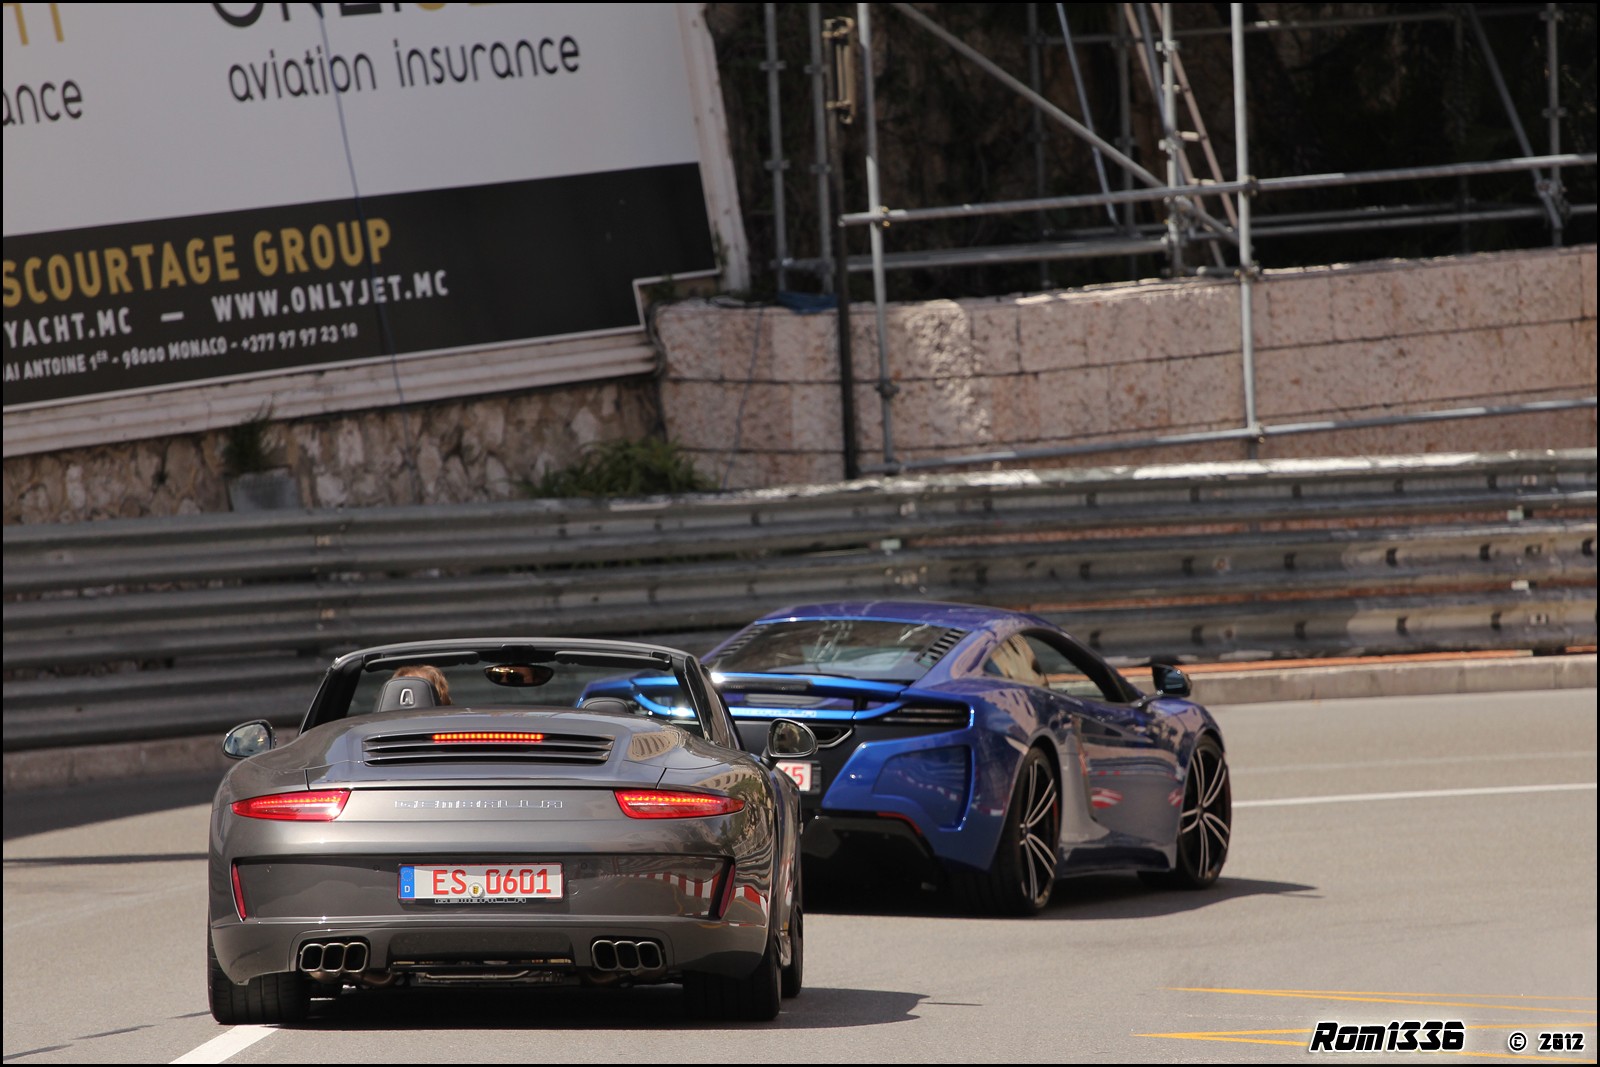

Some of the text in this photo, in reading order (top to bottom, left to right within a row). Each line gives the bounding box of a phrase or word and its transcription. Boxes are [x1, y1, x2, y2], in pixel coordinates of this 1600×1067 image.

[228, 34, 580, 102] aviation insurance
[3, 218, 392, 308] SCOURTAGE GROUP
[3, 308, 132, 348] YACHT.MC
[211, 270, 449, 323] WWW.ONLYJET.MC
[3, 362, 20, 382] AI
[24, 354, 86, 379] ANTOINE
[168, 337, 227, 360] MONACO
[279, 329, 296, 349] 97
[300, 327, 317, 346] 97
[432, 868, 552, 895] ES 0601
